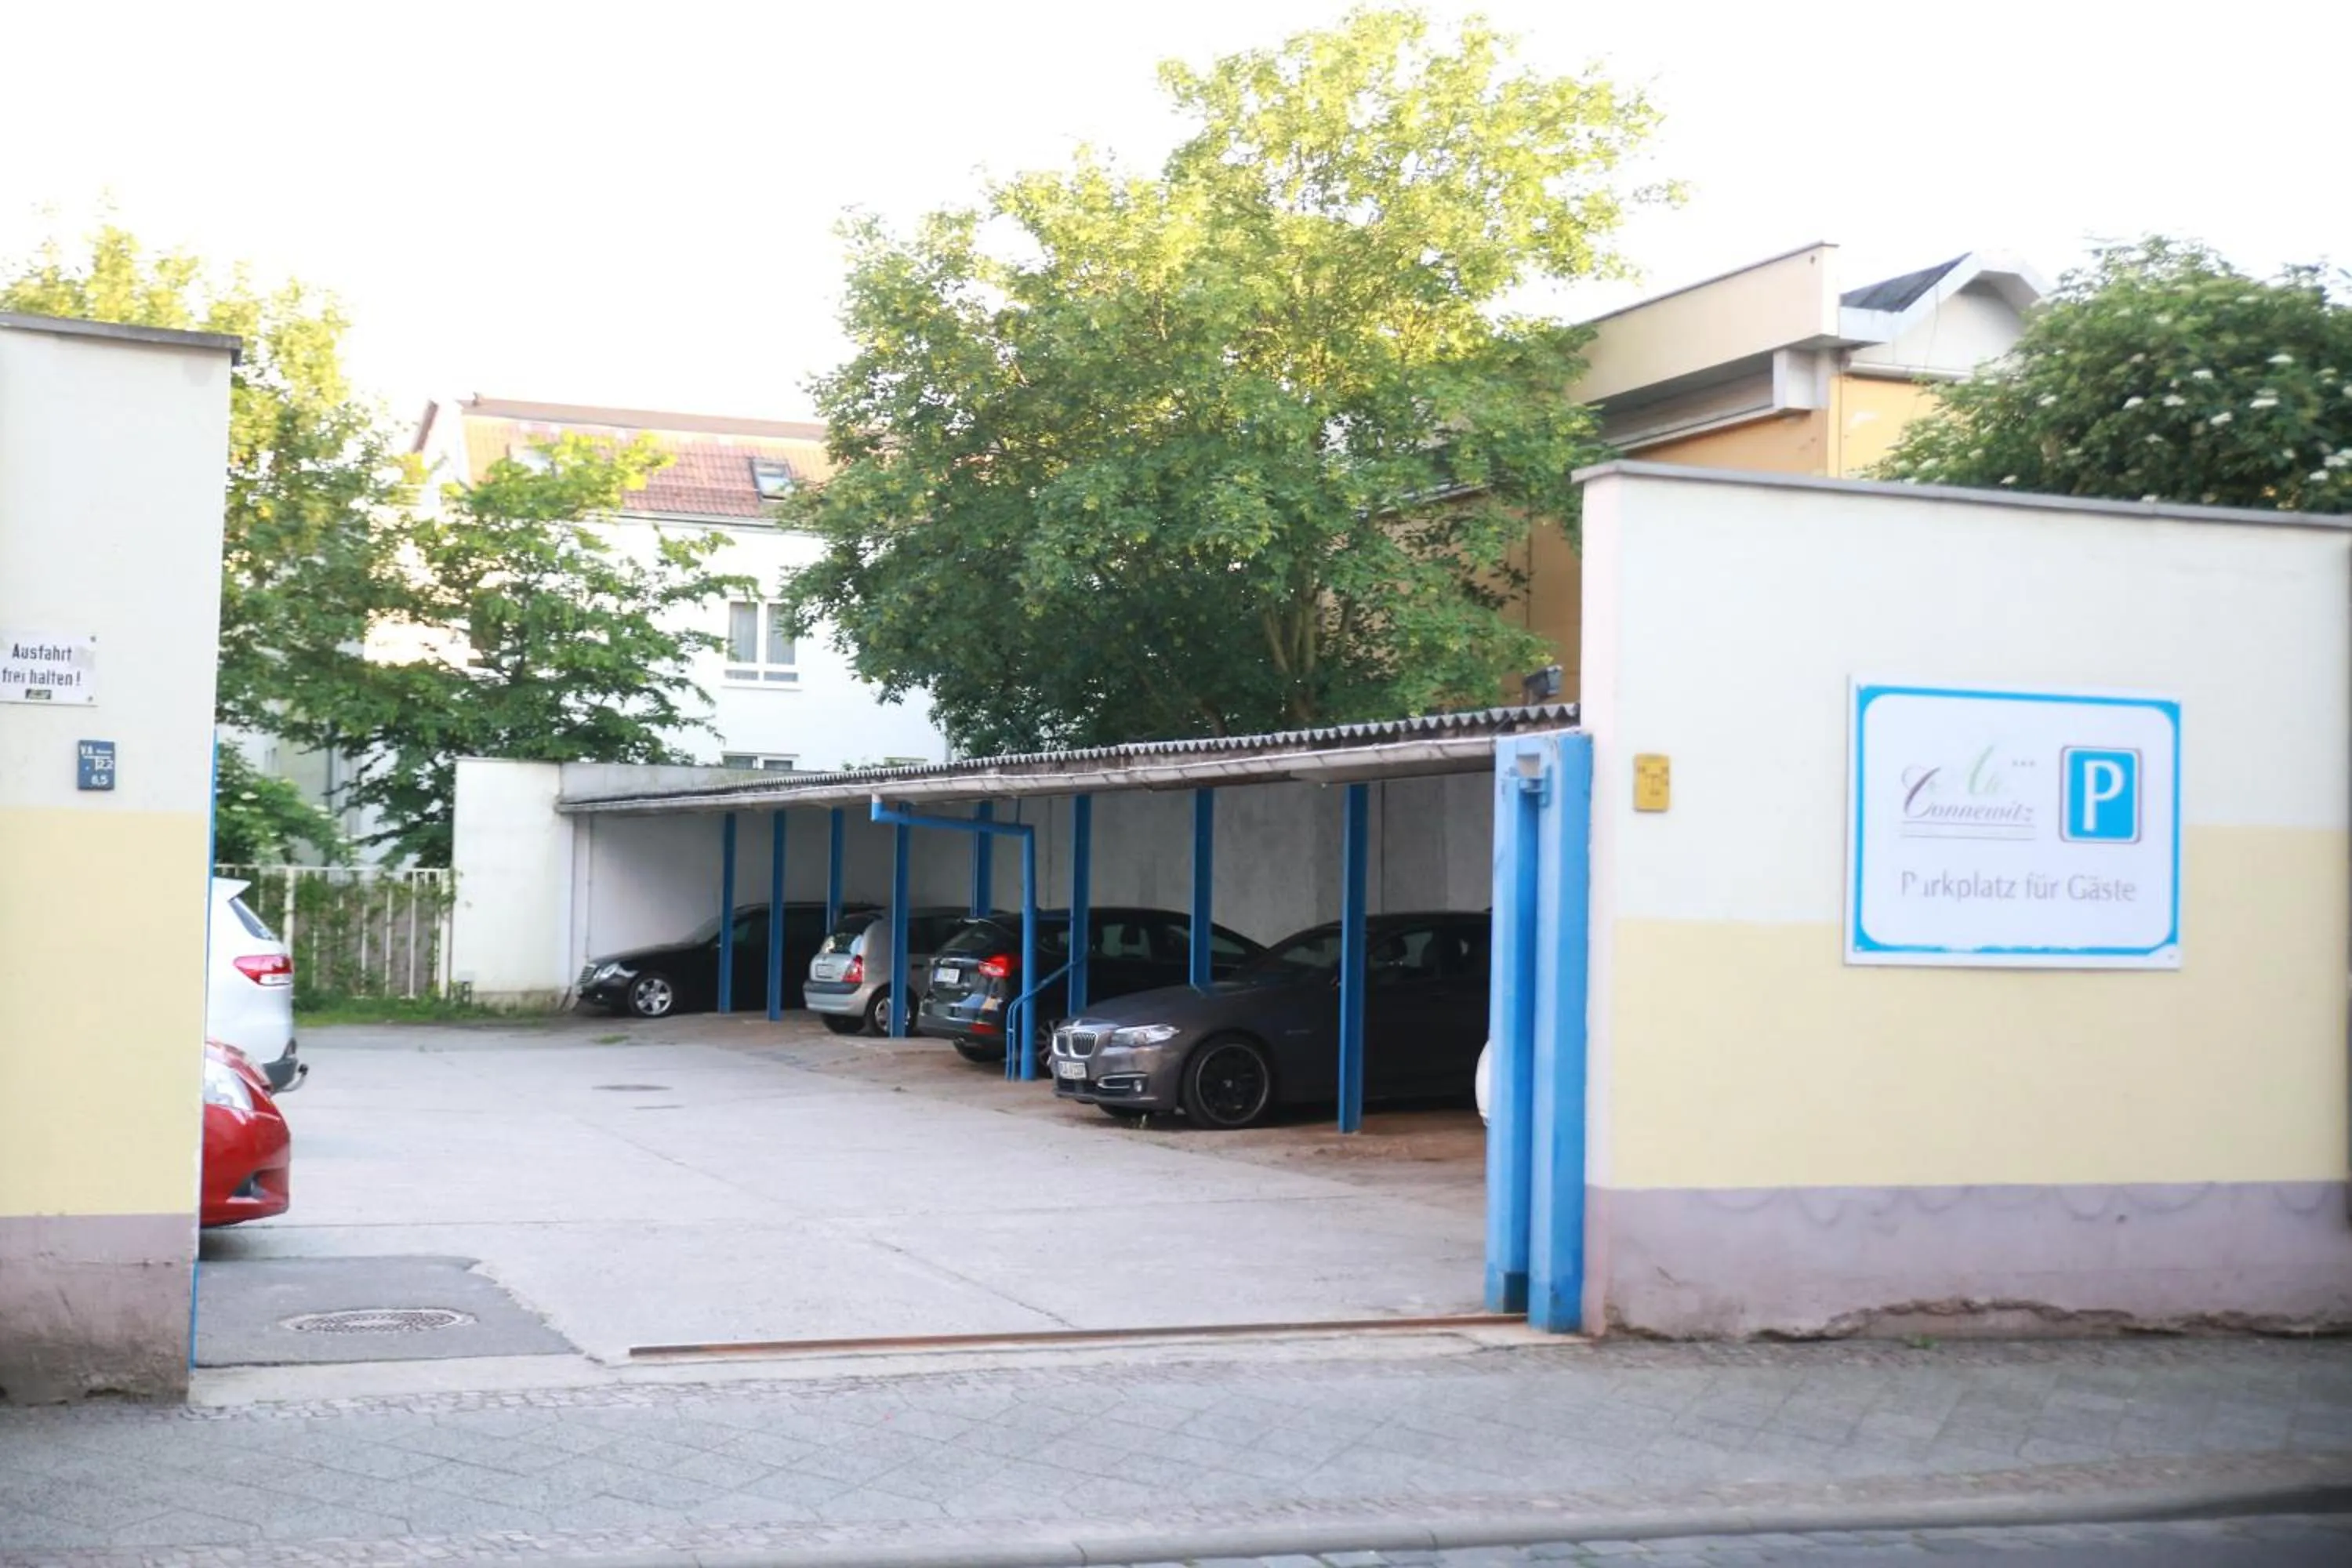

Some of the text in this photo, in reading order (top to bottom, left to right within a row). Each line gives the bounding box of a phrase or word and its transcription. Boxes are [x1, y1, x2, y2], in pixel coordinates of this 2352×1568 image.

[12, 643, 72, 662] Ausfahrt
[2, 667, 27, 684] frei
[2082, 759, 2125, 832] P
[2026, 872, 2060, 900] für
[2067, 873, 2136, 902] Gäste
